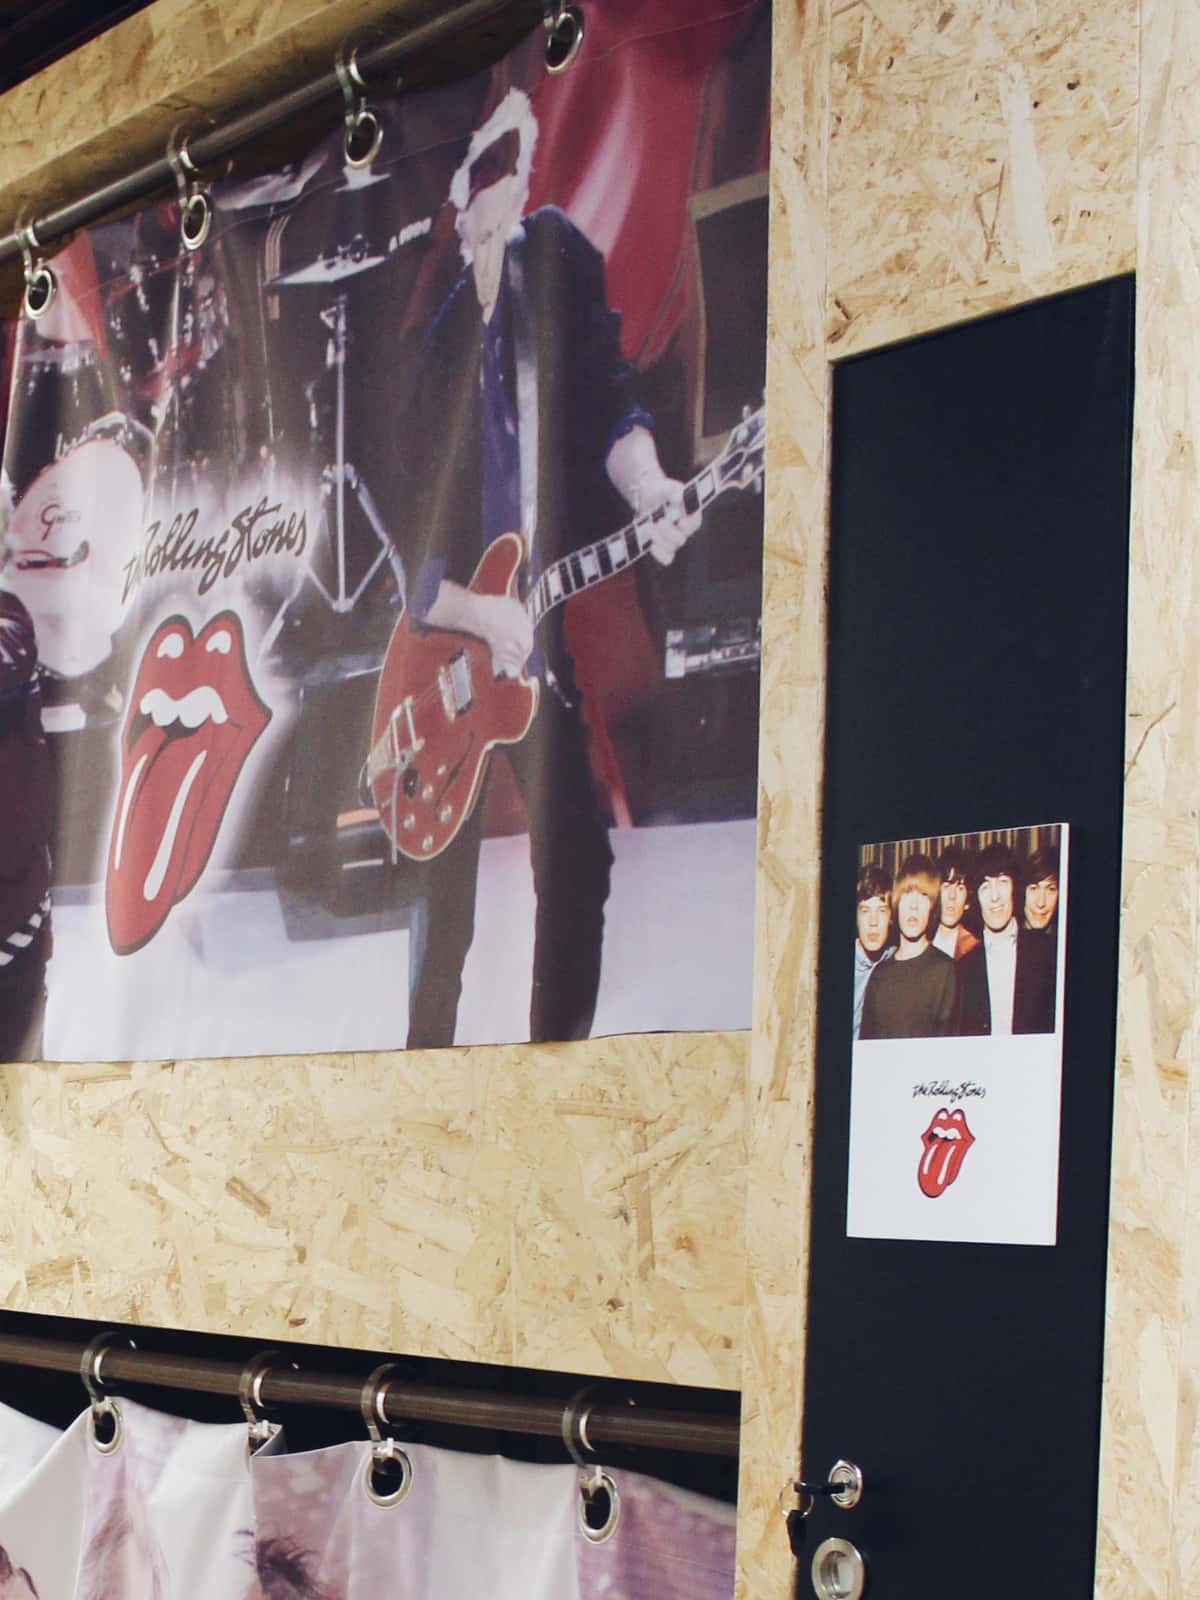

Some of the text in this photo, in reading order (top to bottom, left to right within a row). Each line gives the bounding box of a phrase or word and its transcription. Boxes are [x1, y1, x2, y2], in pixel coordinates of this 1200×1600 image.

[223, 496, 307, 578] Stones
[928, 1079, 959, 1103] Rolling
[957, 1080, 986, 1100] Stones
